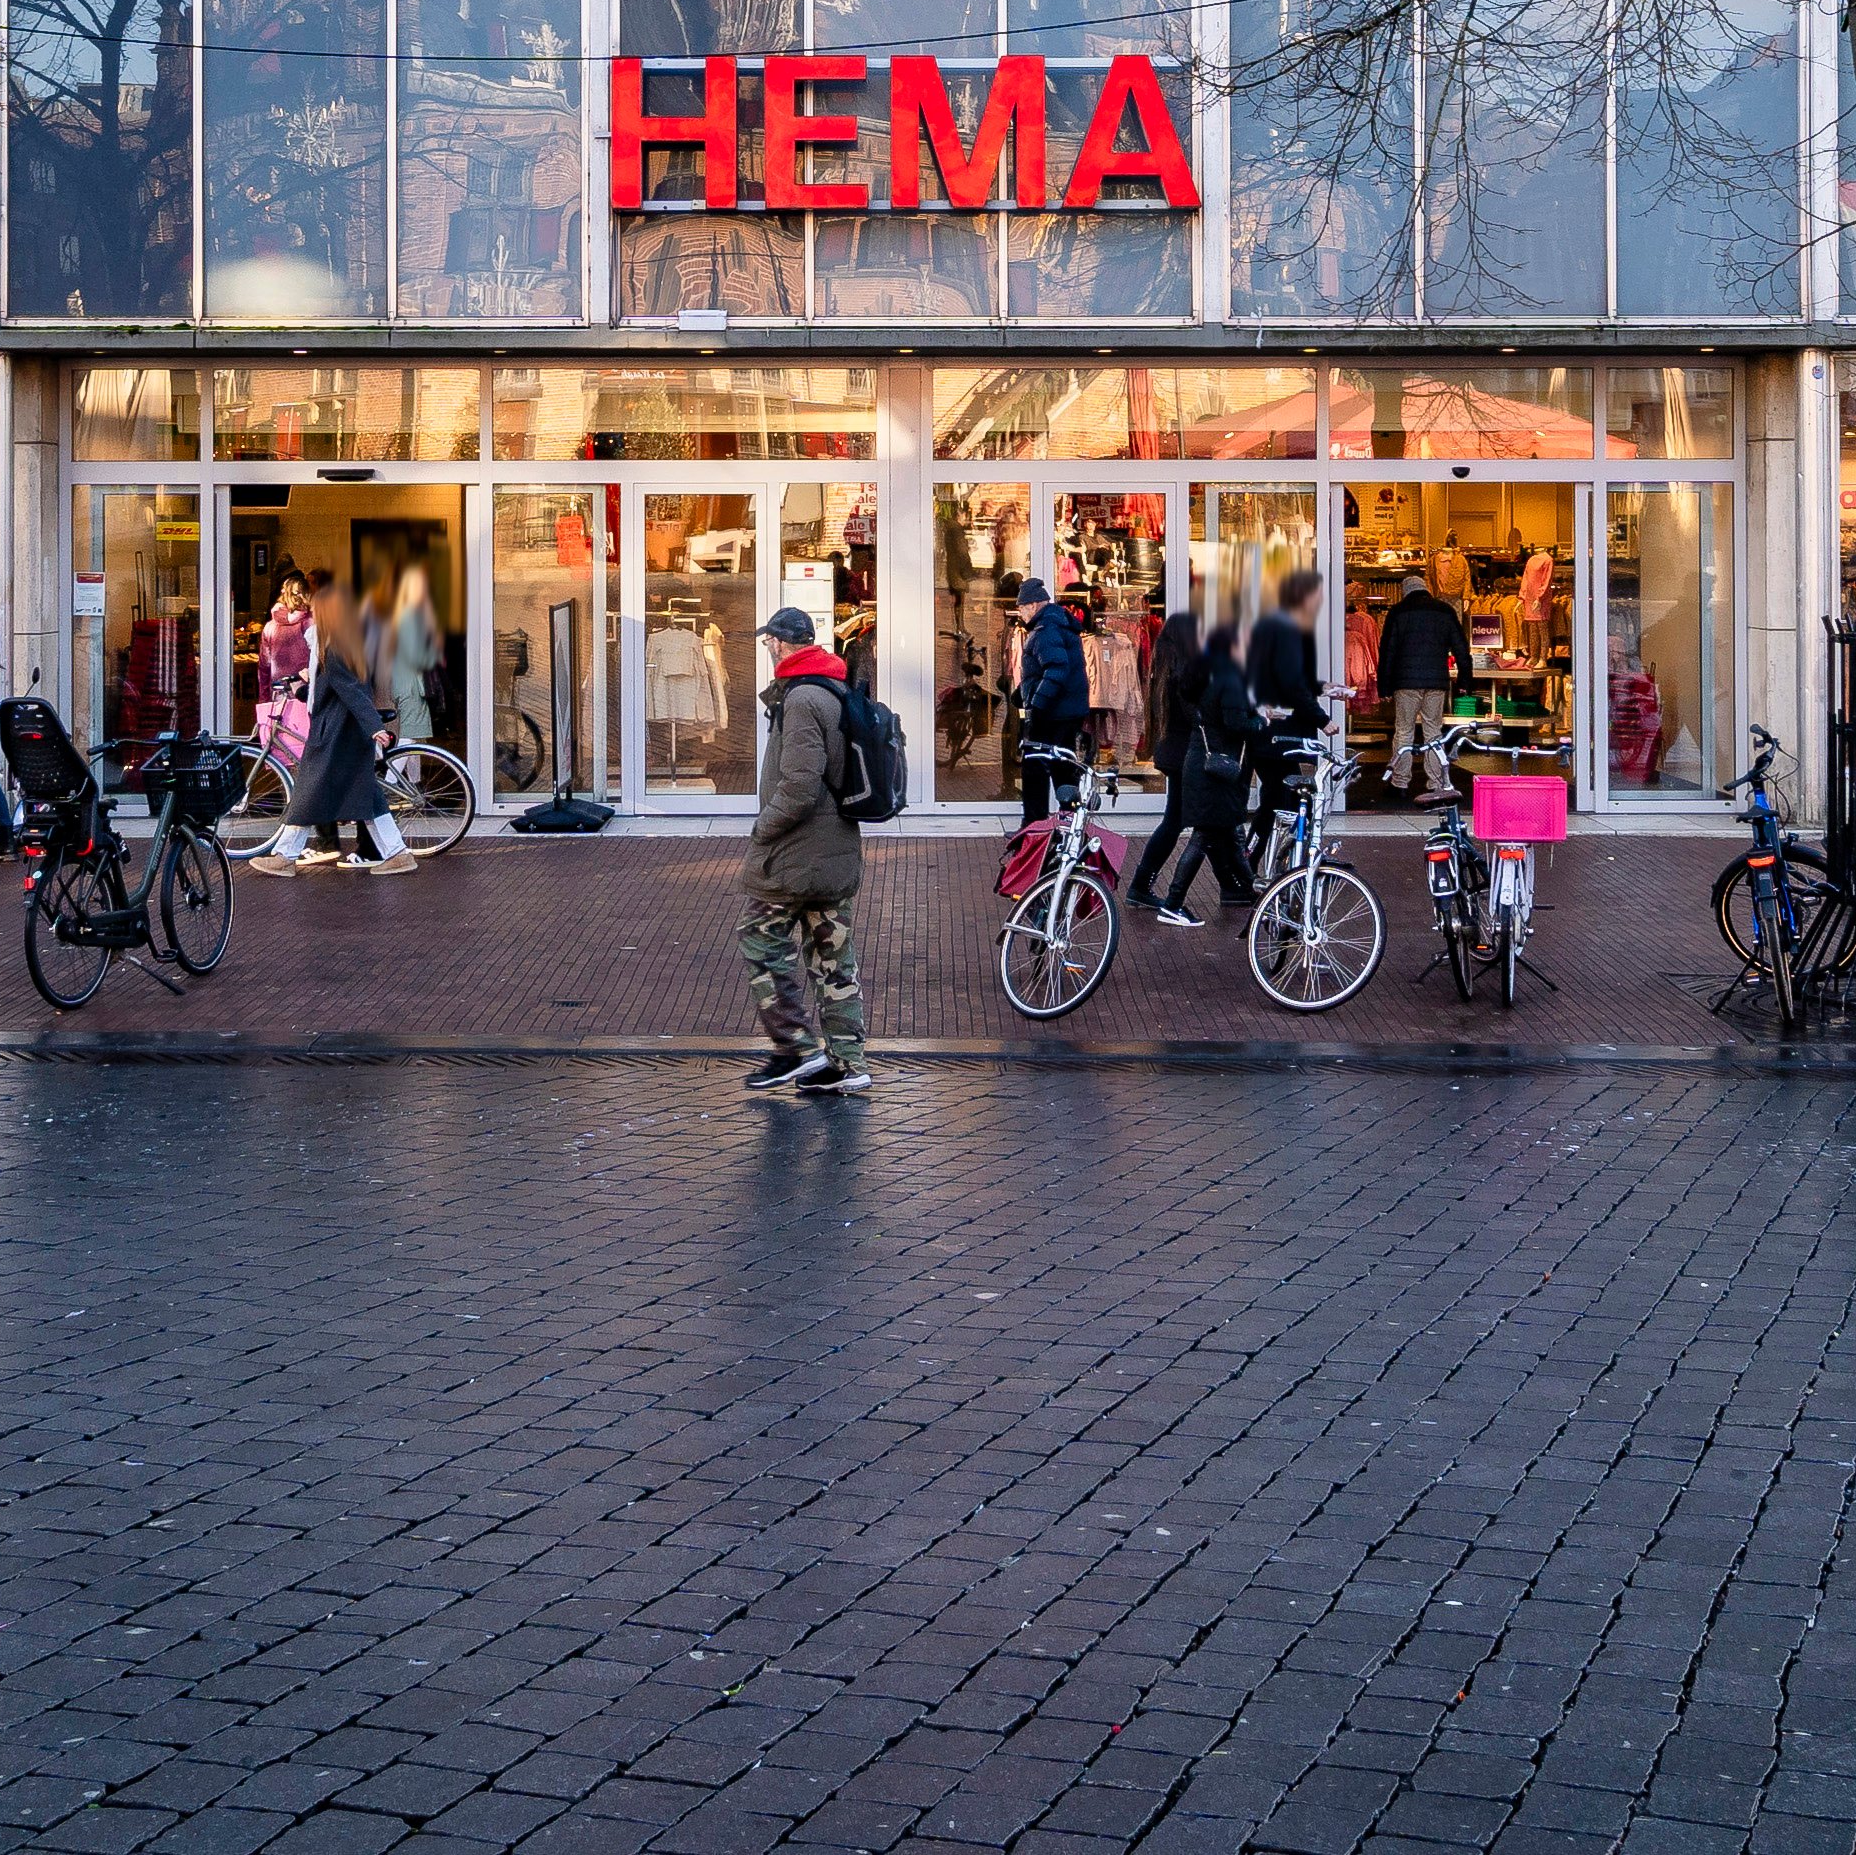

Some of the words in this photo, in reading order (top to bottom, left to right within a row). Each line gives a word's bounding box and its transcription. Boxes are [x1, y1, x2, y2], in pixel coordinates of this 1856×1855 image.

[610, 54, 1202, 211] HEMA
[162, 527, 195, 536] DHL
[1472, 625, 1500, 635] nieuw
